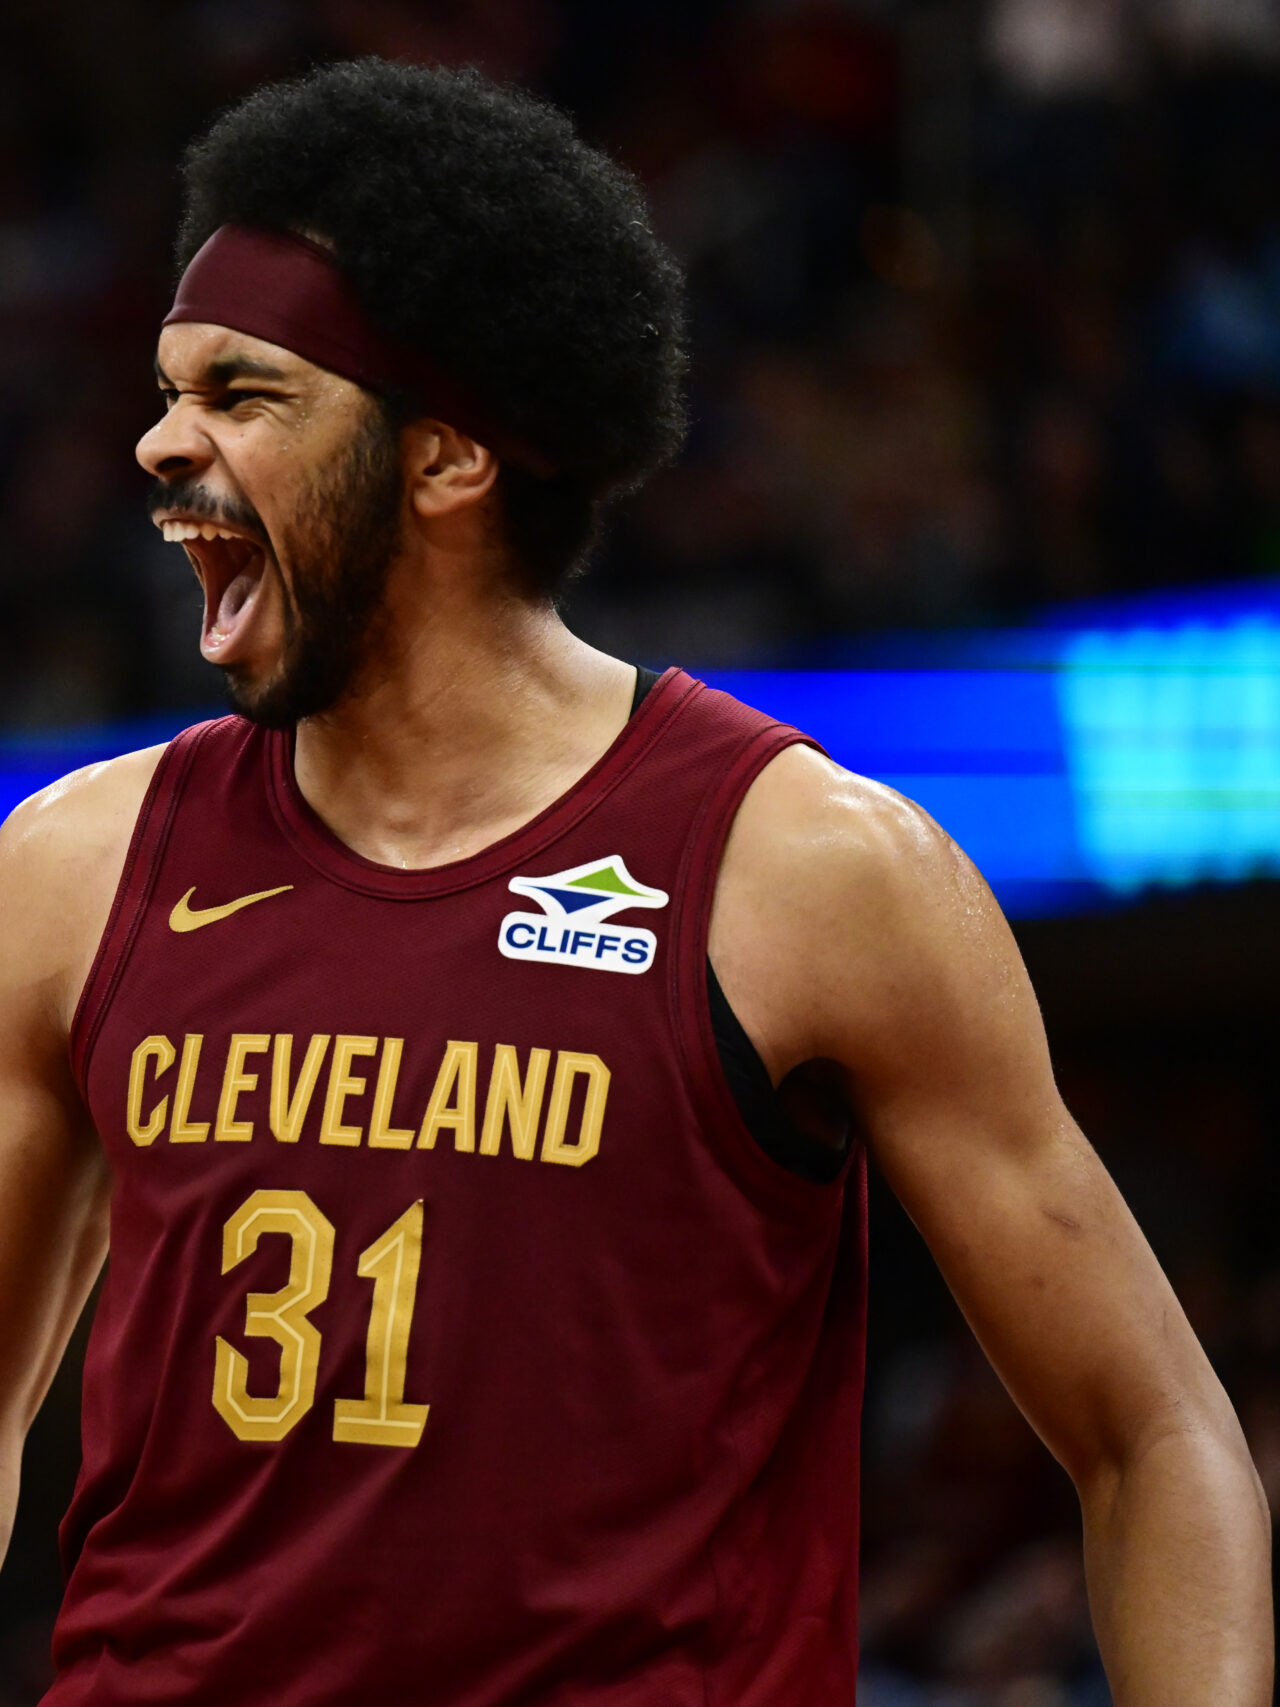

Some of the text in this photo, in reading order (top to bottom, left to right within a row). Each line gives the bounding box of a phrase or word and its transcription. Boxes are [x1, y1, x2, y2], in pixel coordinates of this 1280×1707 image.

[505, 922, 650, 964] CLIFFS
[125, 1032, 613, 1168] CLEVELAND
[211, 1188, 432, 1449] 31
